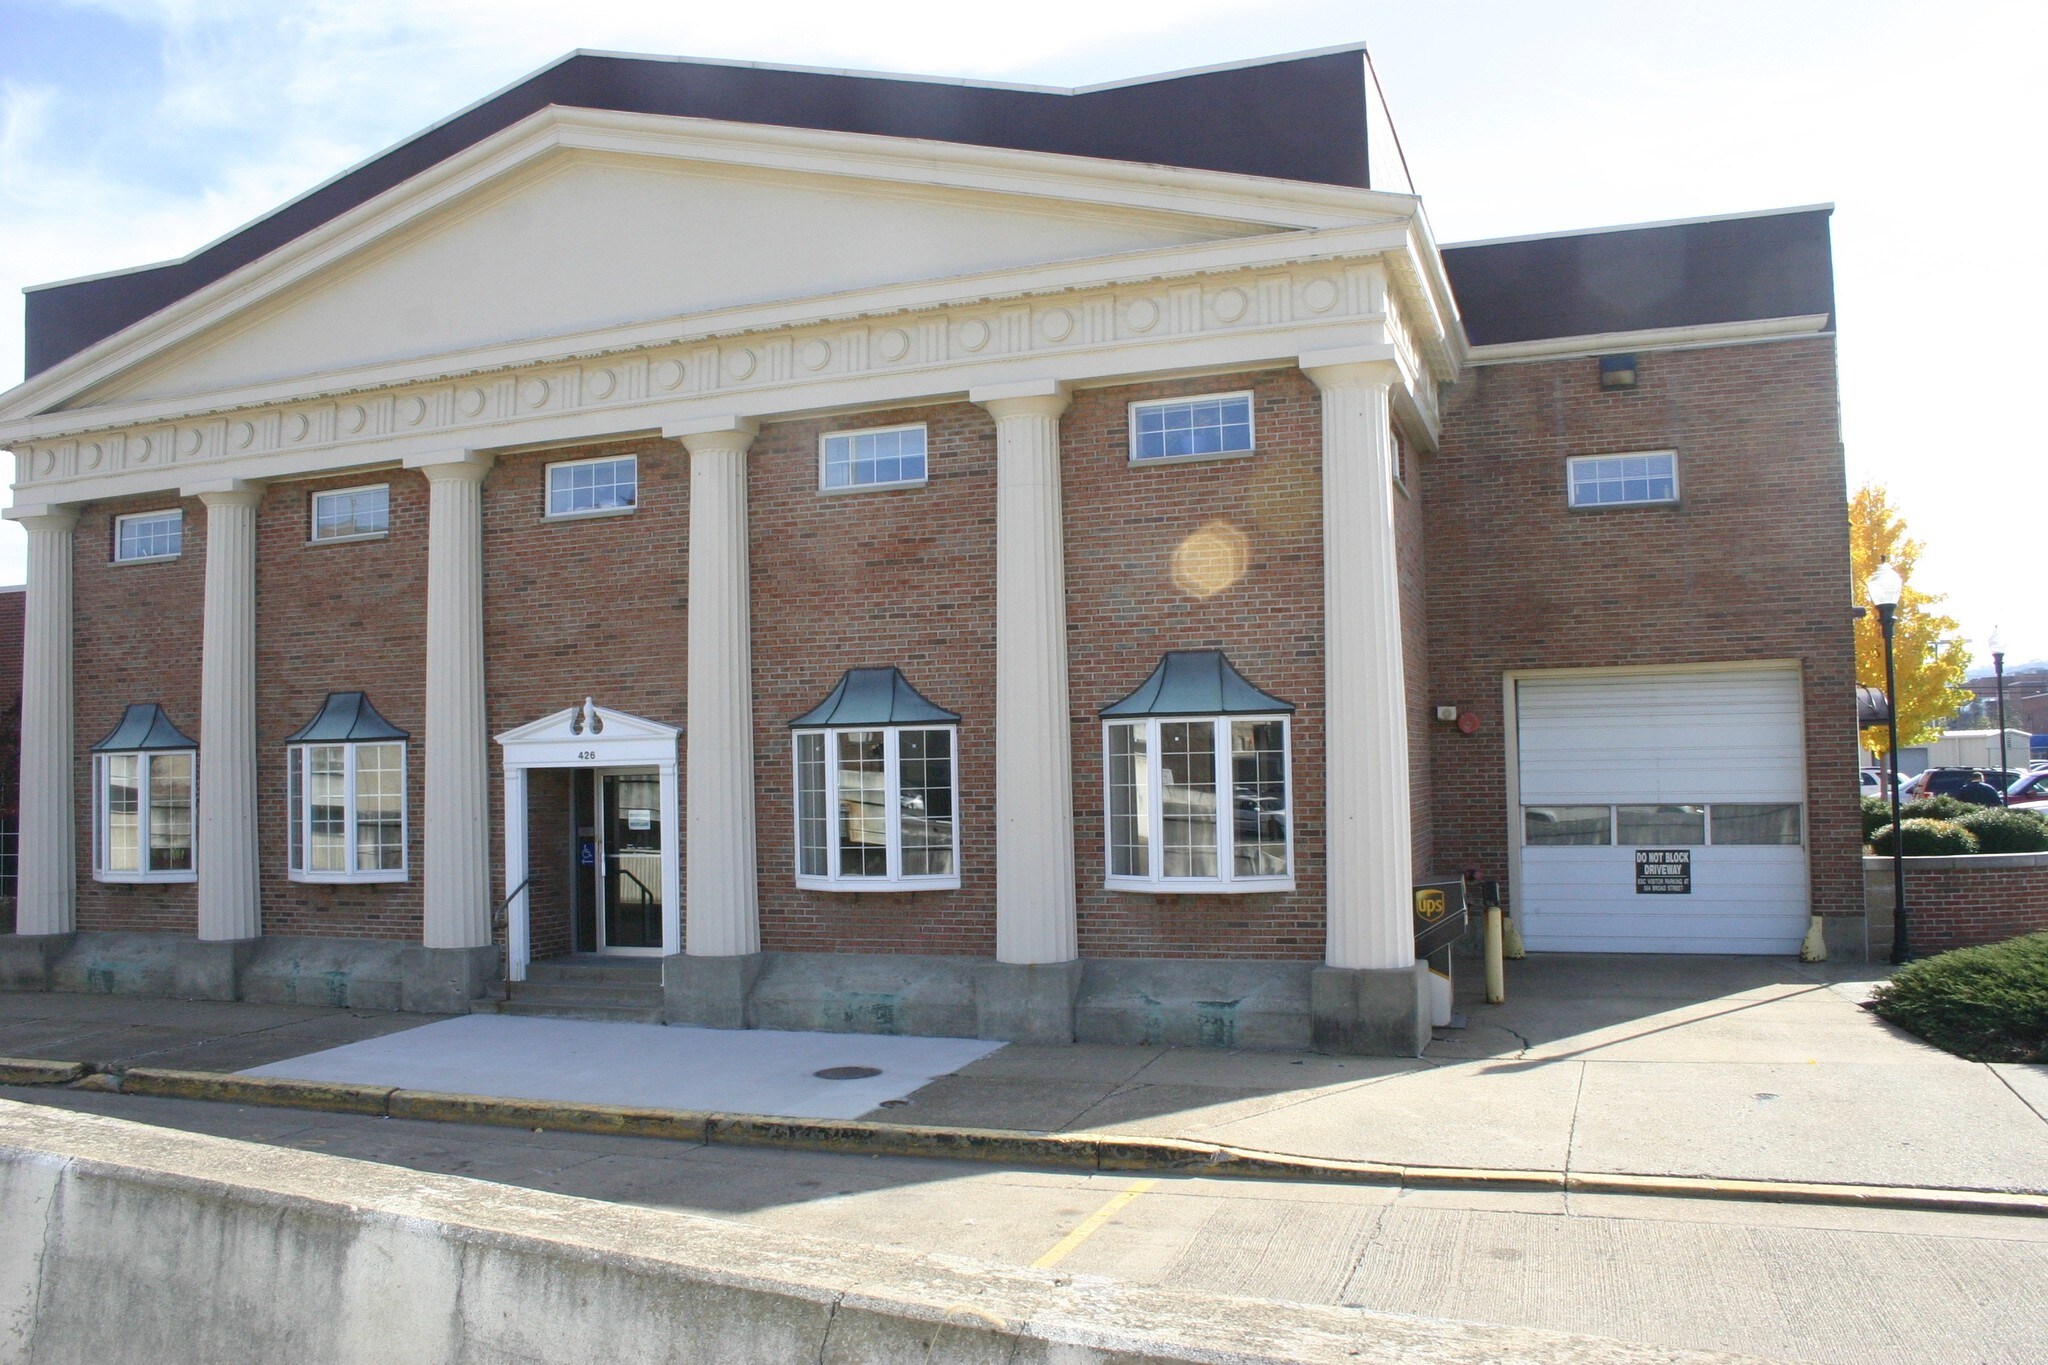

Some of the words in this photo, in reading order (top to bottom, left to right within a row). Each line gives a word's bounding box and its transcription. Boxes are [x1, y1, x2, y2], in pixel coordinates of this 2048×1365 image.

[578, 751, 596, 760] 426
[1636, 852, 1648, 863] DO
[1648, 852, 1664, 863] NOT
[1665, 852, 1689, 863] BLOCK
[1644, 864, 1682, 875] DRIVEWAY
[1419, 899, 1443, 917] ups
